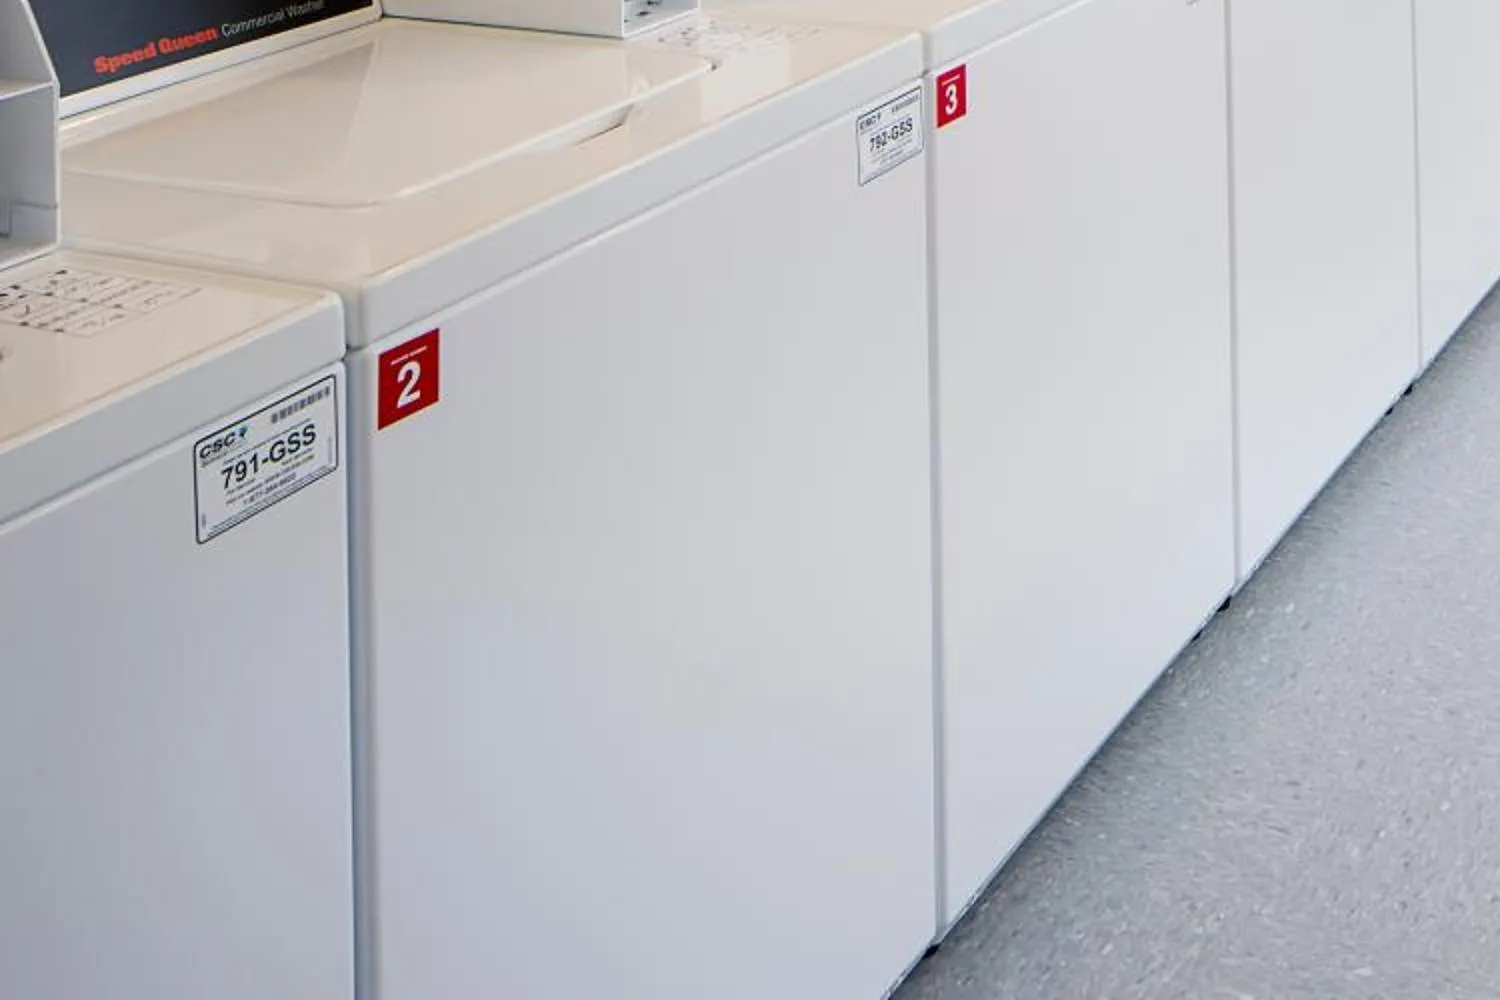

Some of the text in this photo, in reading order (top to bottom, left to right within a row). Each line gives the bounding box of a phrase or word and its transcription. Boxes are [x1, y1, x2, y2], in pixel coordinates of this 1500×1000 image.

[94, 42, 157, 74] Speed
[158, 27, 220, 54] Queen
[221, 7, 285, 37] Commercial
[945, 83, 958, 115] 3
[396, 361, 420, 408] 2
[199, 431, 236, 460] CSC
[221, 423, 317, 490] 791-GSS
